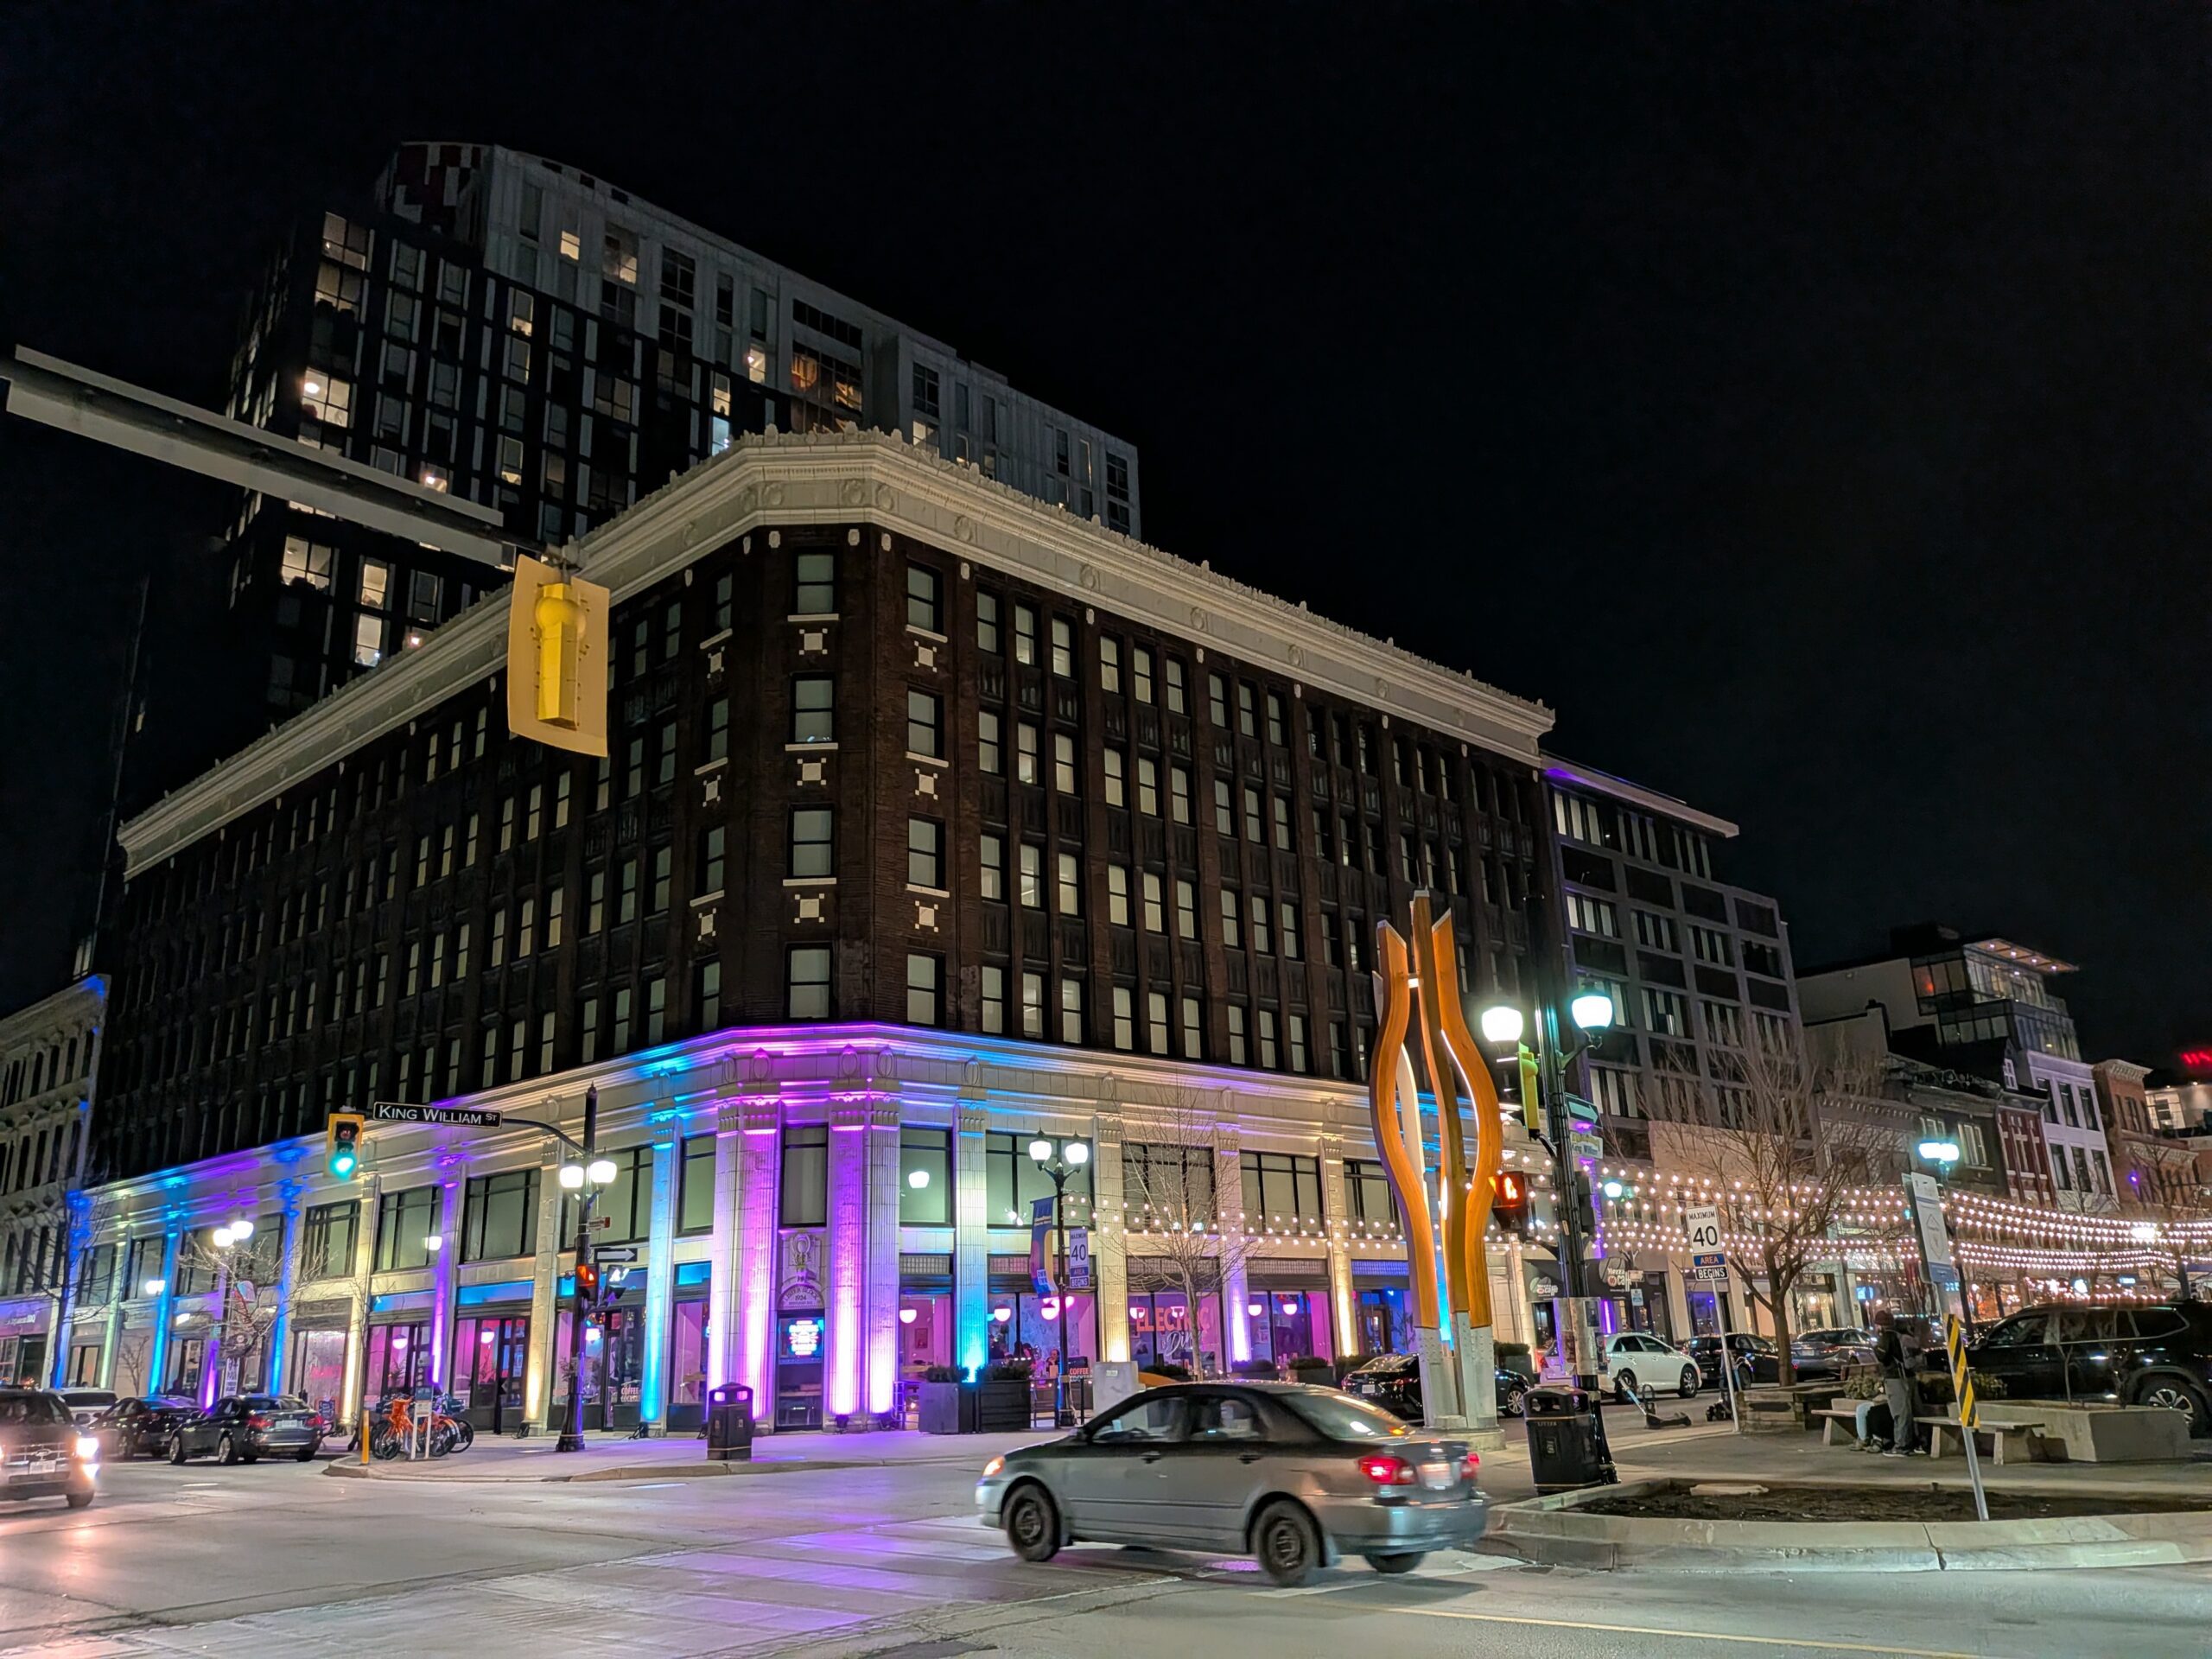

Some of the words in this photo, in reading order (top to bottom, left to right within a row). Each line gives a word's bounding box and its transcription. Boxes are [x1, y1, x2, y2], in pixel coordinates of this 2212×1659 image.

[378, 1104, 417, 1120] KING
[423, 1109, 481, 1124] WILLIAM
[1688, 1211, 1715, 1220] MAXIMUM
[1693, 1225, 1718, 1247] 40
[1071, 1244, 1086, 1262] 40
[1700, 1255, 1719, 1266] AREA
[1698, 1268, 1726, 1279] BEGINS
[1071, 1278, 1088, 1287] BEGINS
